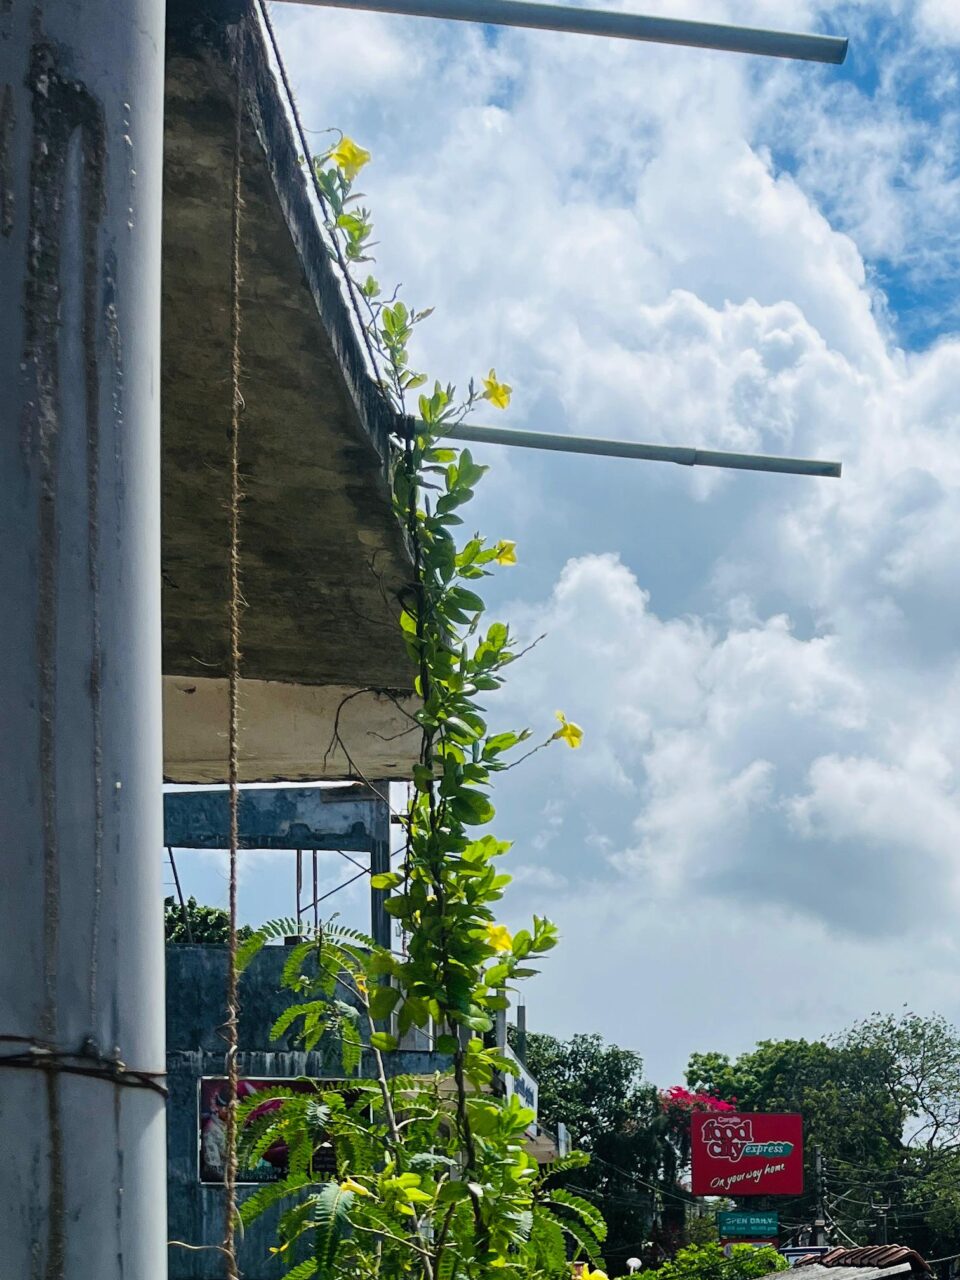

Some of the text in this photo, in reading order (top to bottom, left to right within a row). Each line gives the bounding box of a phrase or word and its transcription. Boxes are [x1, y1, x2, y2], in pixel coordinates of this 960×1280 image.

[745, 1145, 783, 1155] express
[710, 1163, 785, 1190] On your way home
